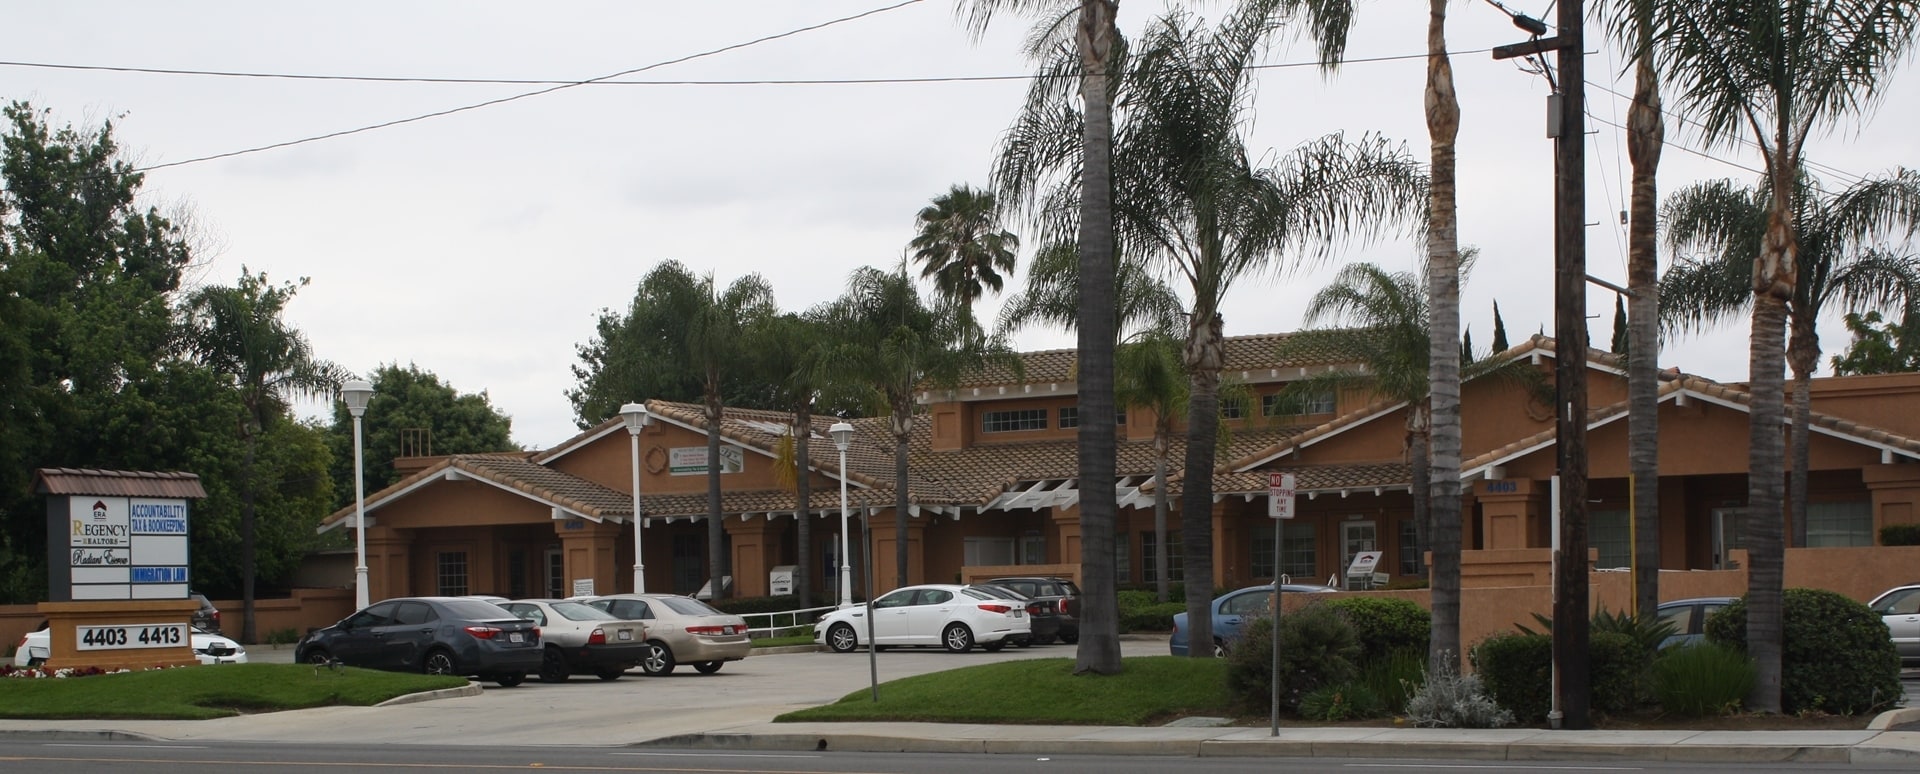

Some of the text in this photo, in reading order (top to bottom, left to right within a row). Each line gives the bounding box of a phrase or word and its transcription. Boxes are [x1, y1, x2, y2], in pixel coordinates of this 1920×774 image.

[1270, 475, 1280, 486] NO
[1270, 488, 1294, 497] STOPPING
[131, 504, 185, 518] ACCOUNTABILITY
[1276, 505, 1287, 513] TIME
[72, 519, 128, 537] REGENCY
[131, 519, 185, 533] TAX & BOOKKEEPING
[82, 537, 119, 545] REALTORS
[72, 548, 103, 565] Radiant
[131, 567, 186, 582] IMMIGRATION LAW
[83, 627, 180, 646] 4403 4413
